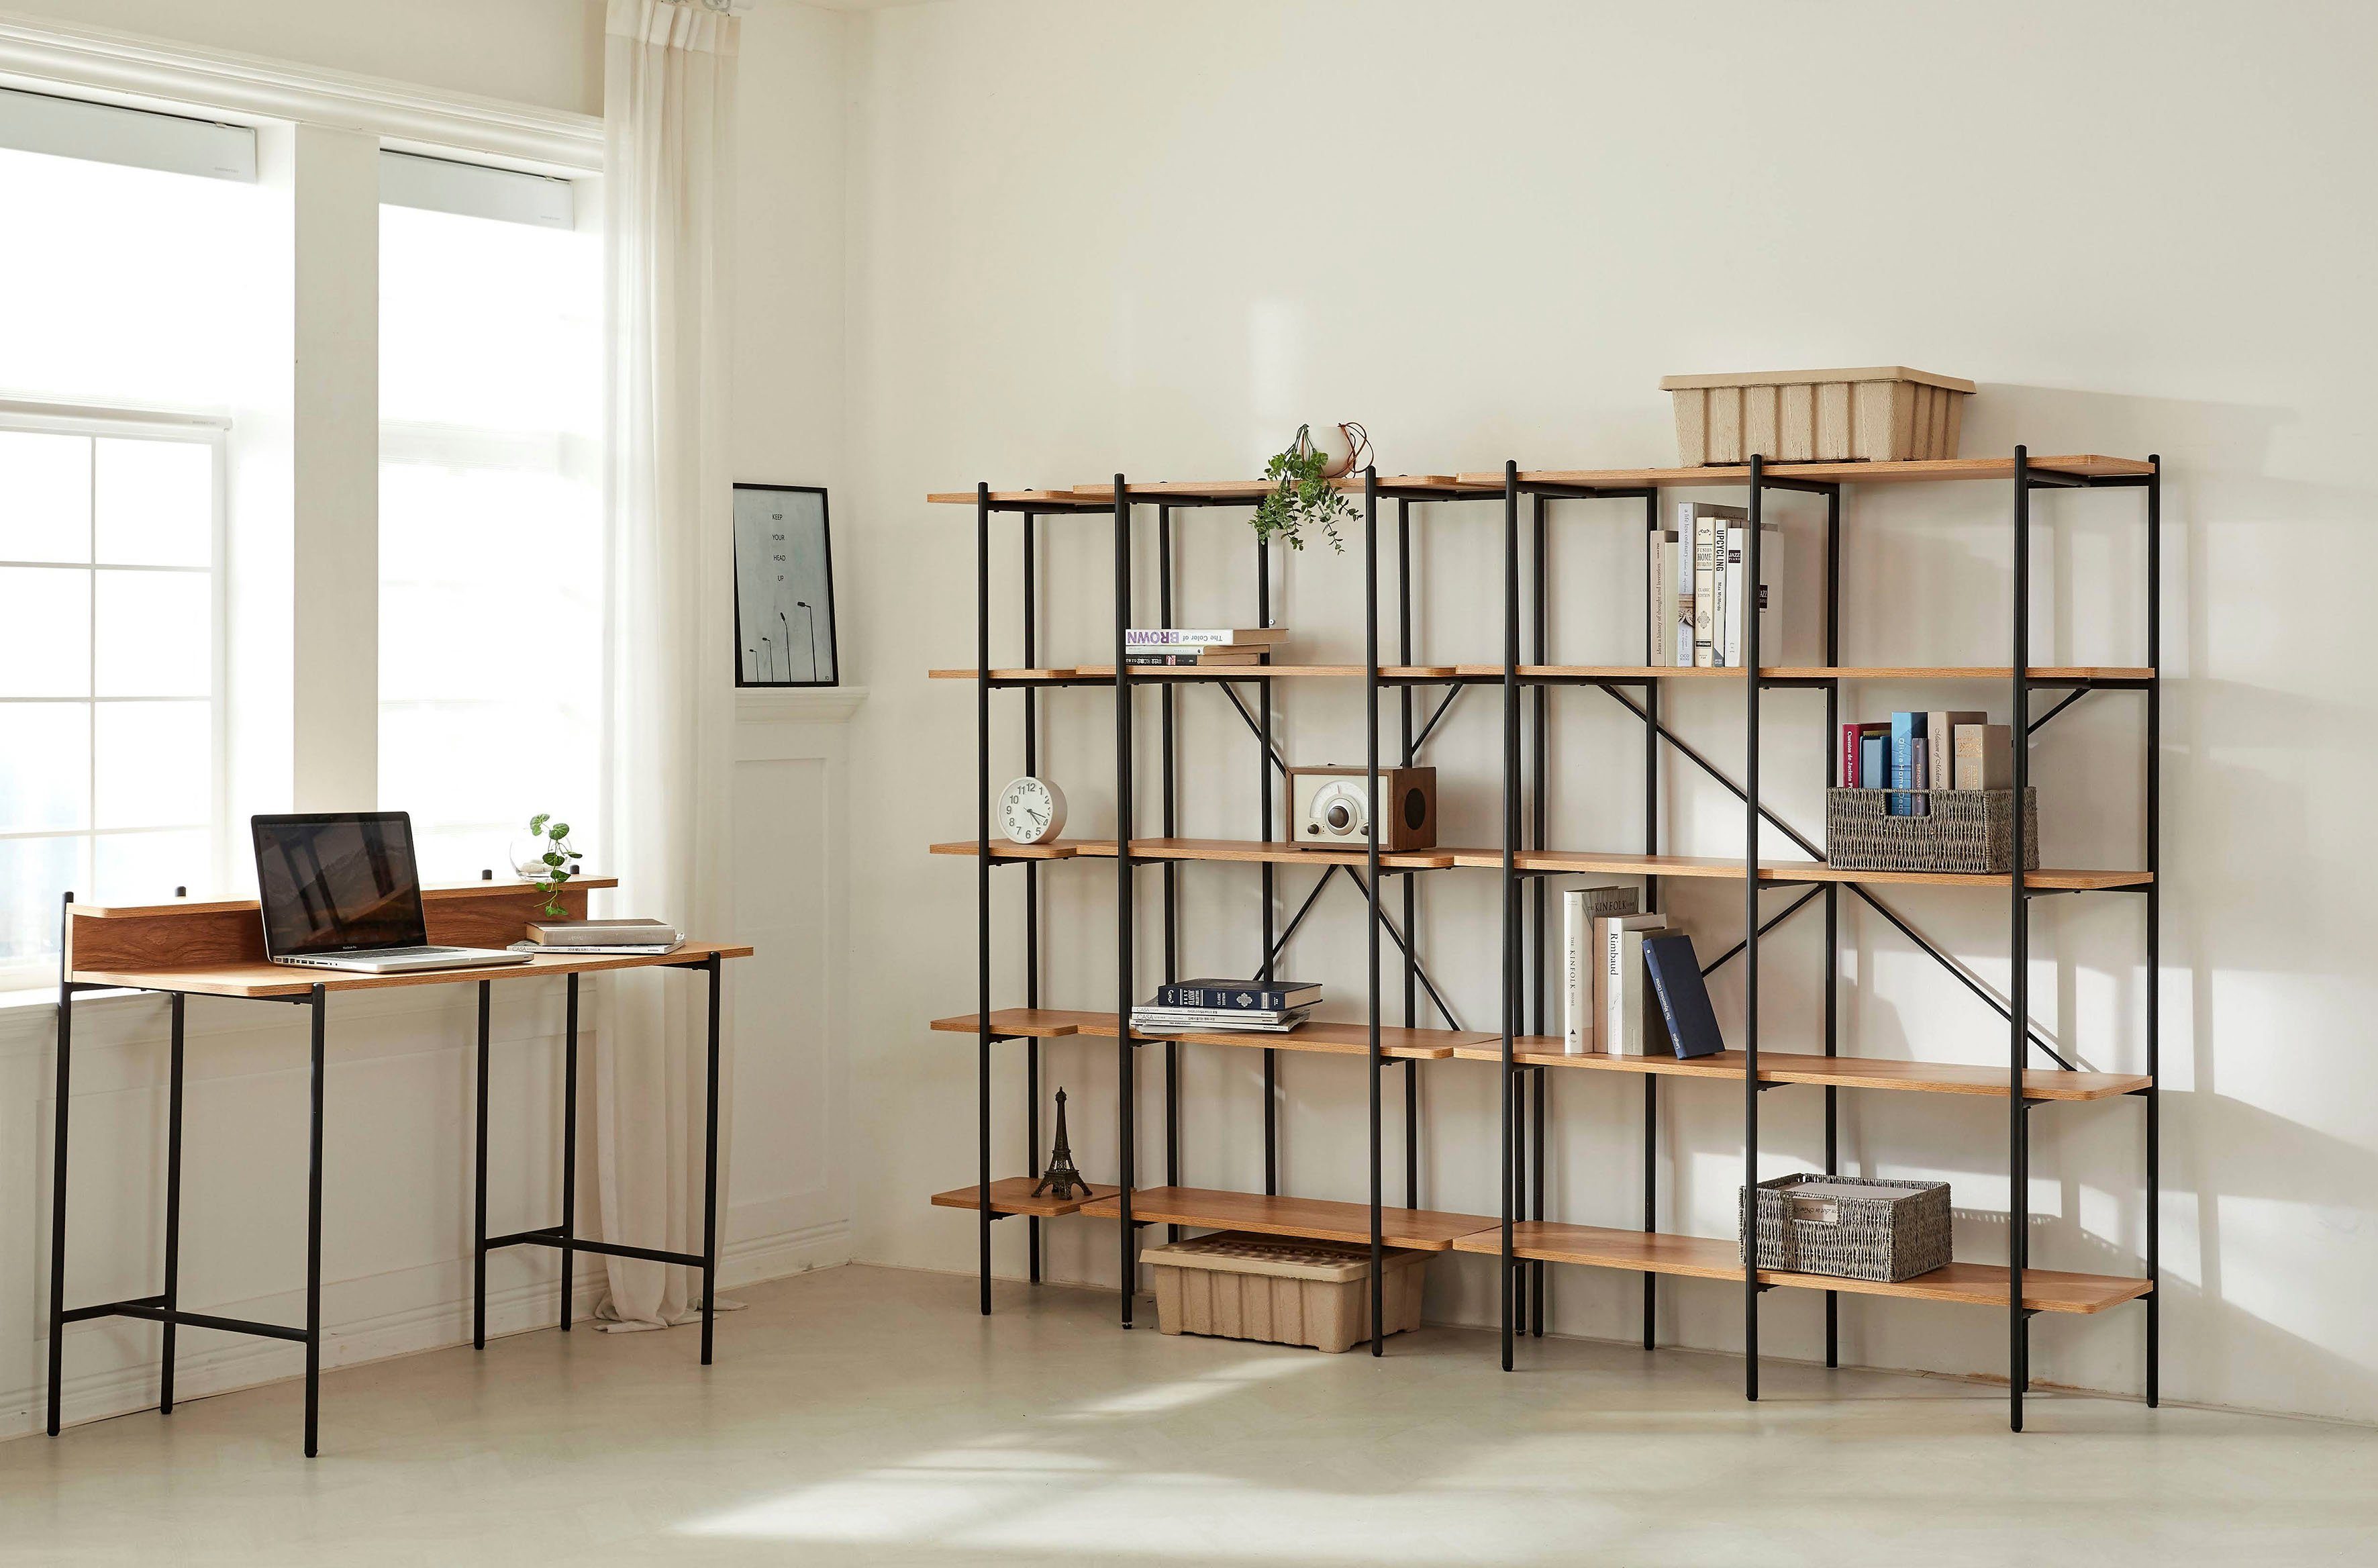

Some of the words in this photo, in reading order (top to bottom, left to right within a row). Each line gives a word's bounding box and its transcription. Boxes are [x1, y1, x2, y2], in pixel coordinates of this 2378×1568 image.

[1716, 530, 1725, 572] UPCYCLING
[1697, 553, 1712, 561] HOME
[1127, 631, 1179, 644] BROWN
[1017, 785, 1025, 795] 11
[1026, 783, 1036, 792] 12
[1039, 787, 1042, 795] 1
[1009, 795, 1019, 804] 10
[1044, 795, 1050, 804] 2
[1006, 805, 1011, 814] 9
[1009, 818, 1015, 826] 8
[1016, 826, 1022, 835] 7
[1026, 830, 1031, 839] 6
[1036, 827, 1041, 836] 5
[1595, 900, 1626, 912] KINFOLK
[1610, 933, 1619, 975] Rimbaud
[1660, 991, 1669, 1012] Mysterious
